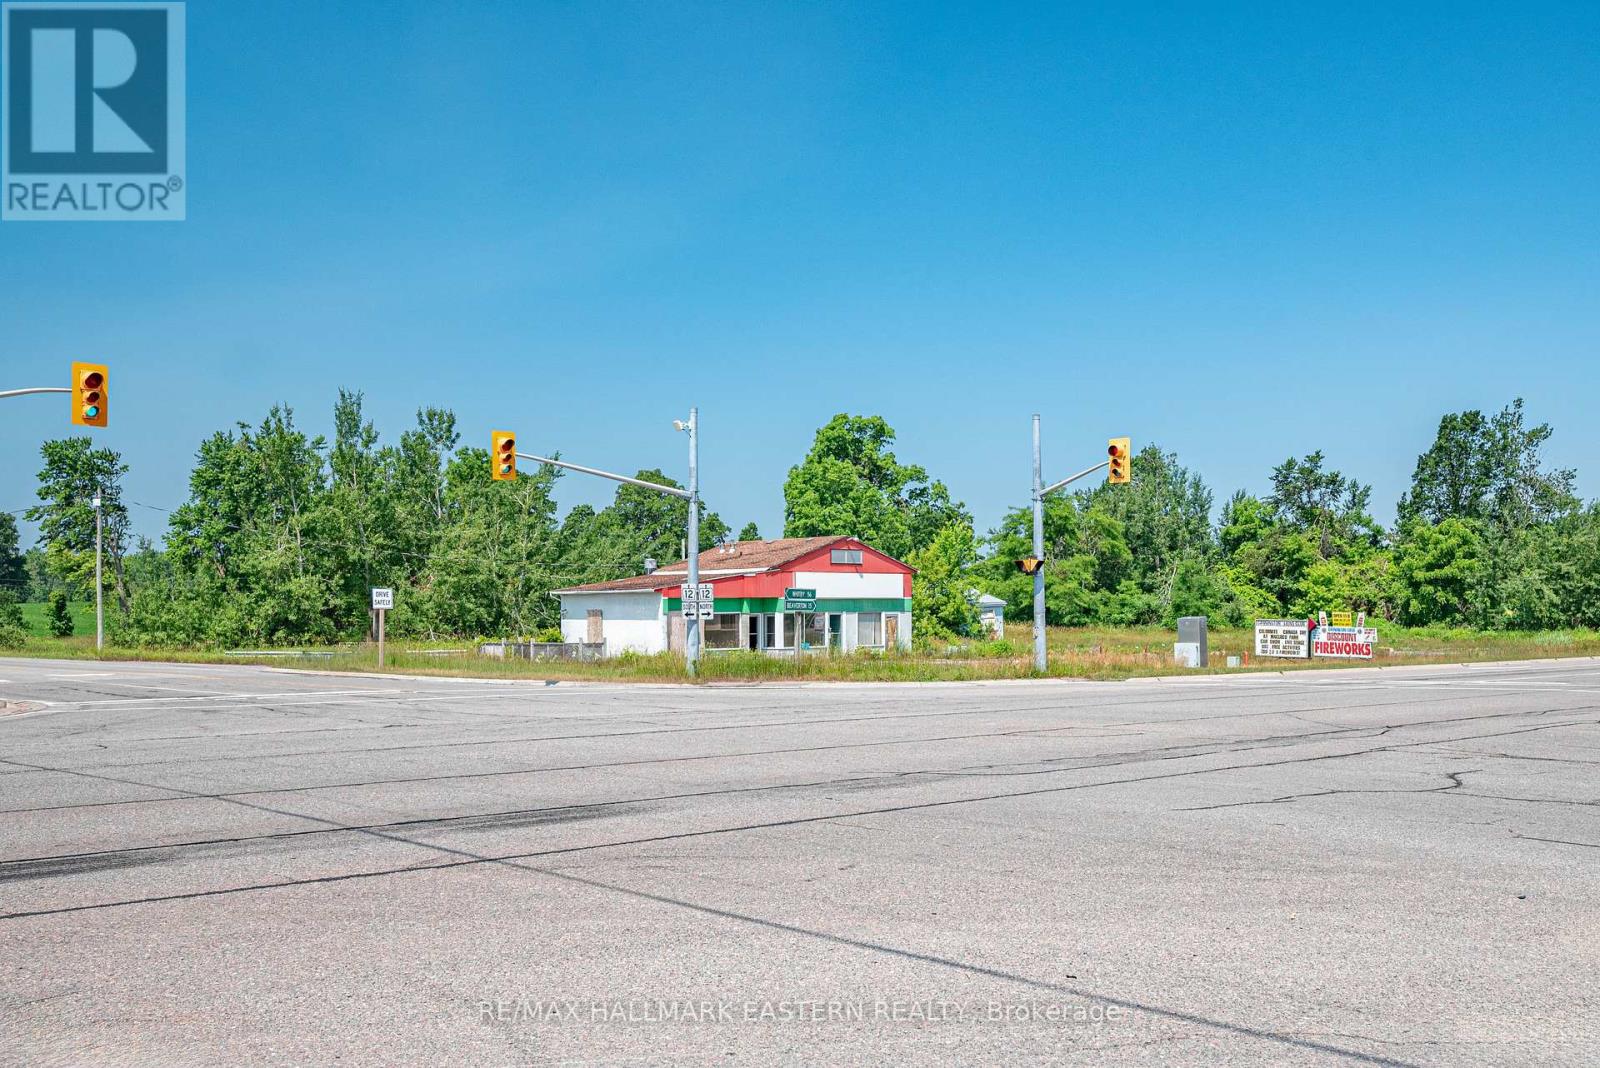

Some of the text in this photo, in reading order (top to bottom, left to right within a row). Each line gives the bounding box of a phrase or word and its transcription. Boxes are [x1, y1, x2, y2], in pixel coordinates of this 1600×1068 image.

[684, 589, 694, 599] 12
[702, 589, 711, 599] 12
[1327, 632, 1357, 642] DISCOUNT
[1314, 641, 1371, 656] FIREWORKS
